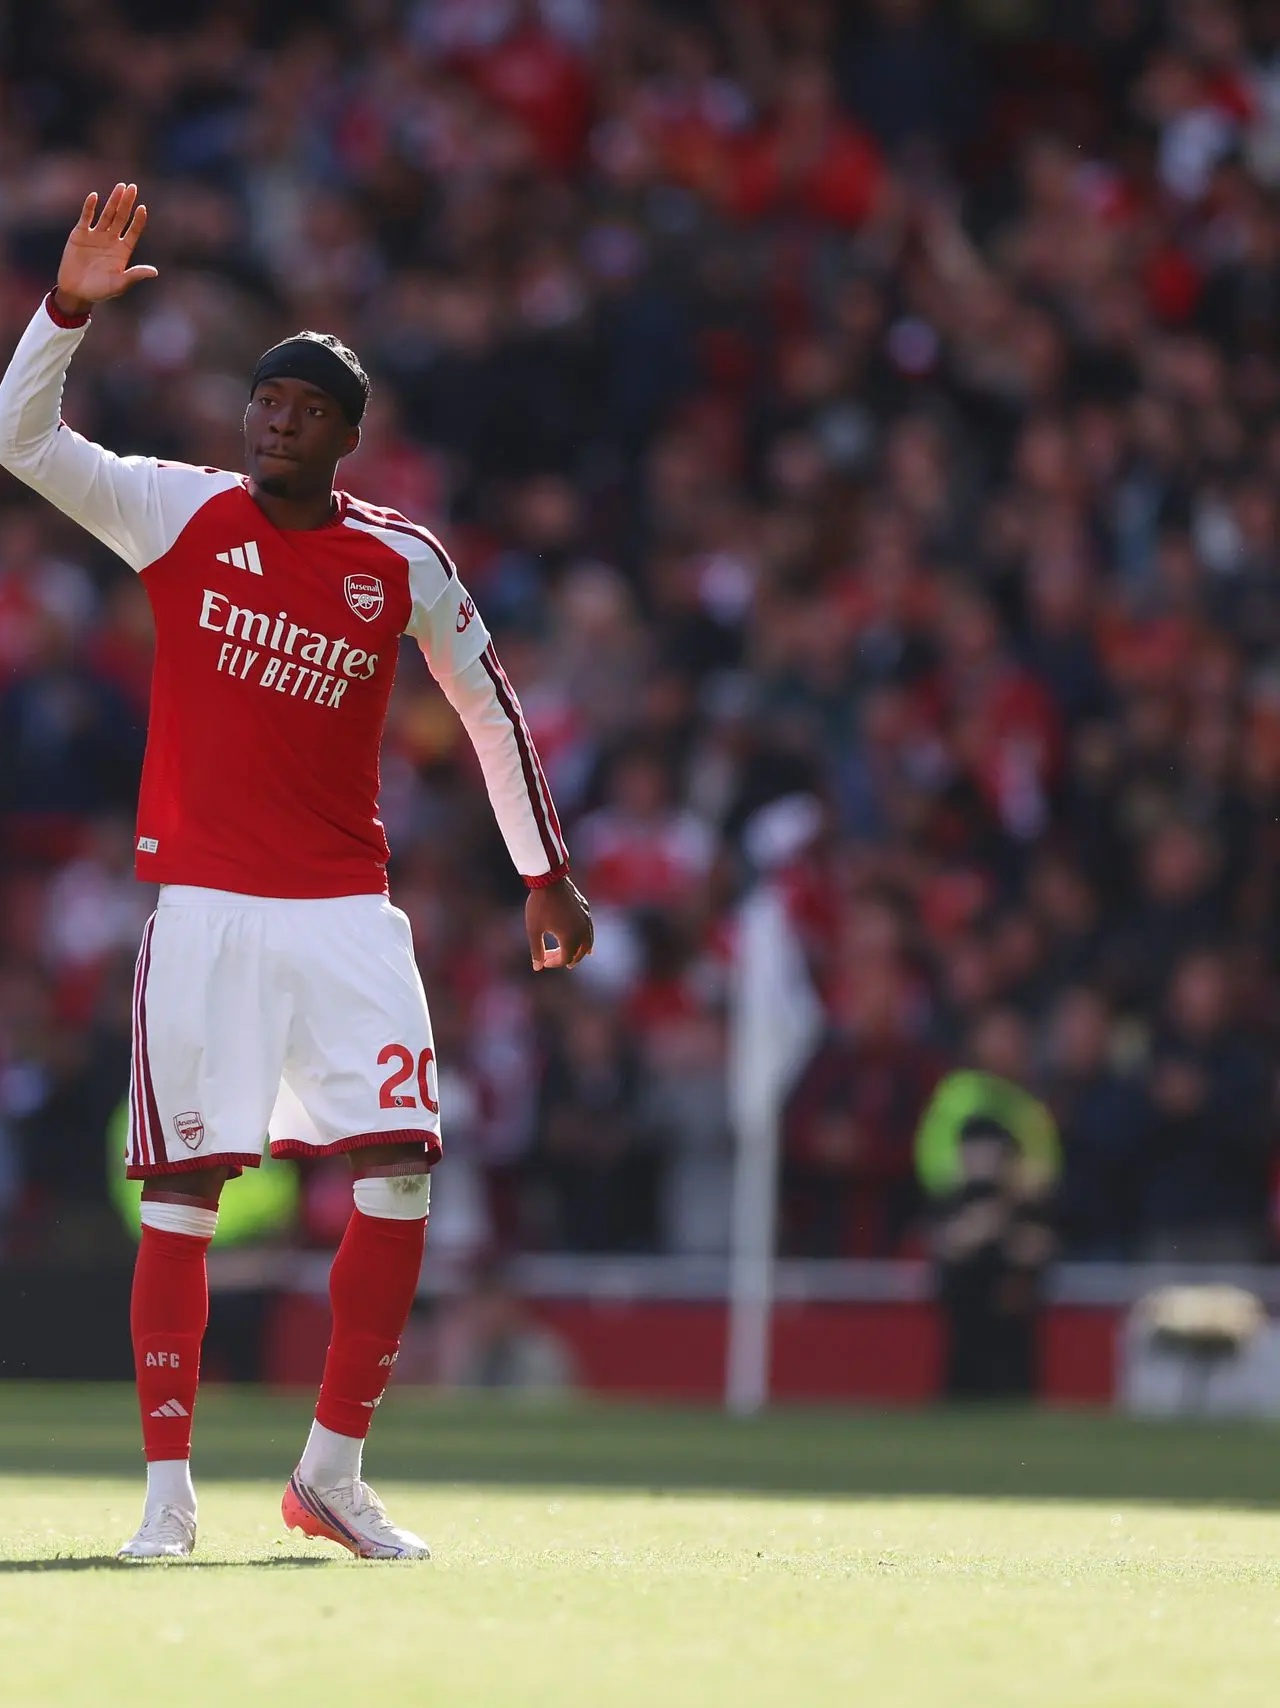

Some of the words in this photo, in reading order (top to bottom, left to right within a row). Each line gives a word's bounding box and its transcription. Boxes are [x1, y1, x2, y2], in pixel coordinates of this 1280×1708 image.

[350, 581, 379, 593] Arsenal
[198, 588, 380, 682] Emirates
[216, 642, 260, 681] FLY
[259, 655, 349, 709] BETTER
[376, 1043, 439, 1115] 20
[146, 1351, 180, 1369] AFC
